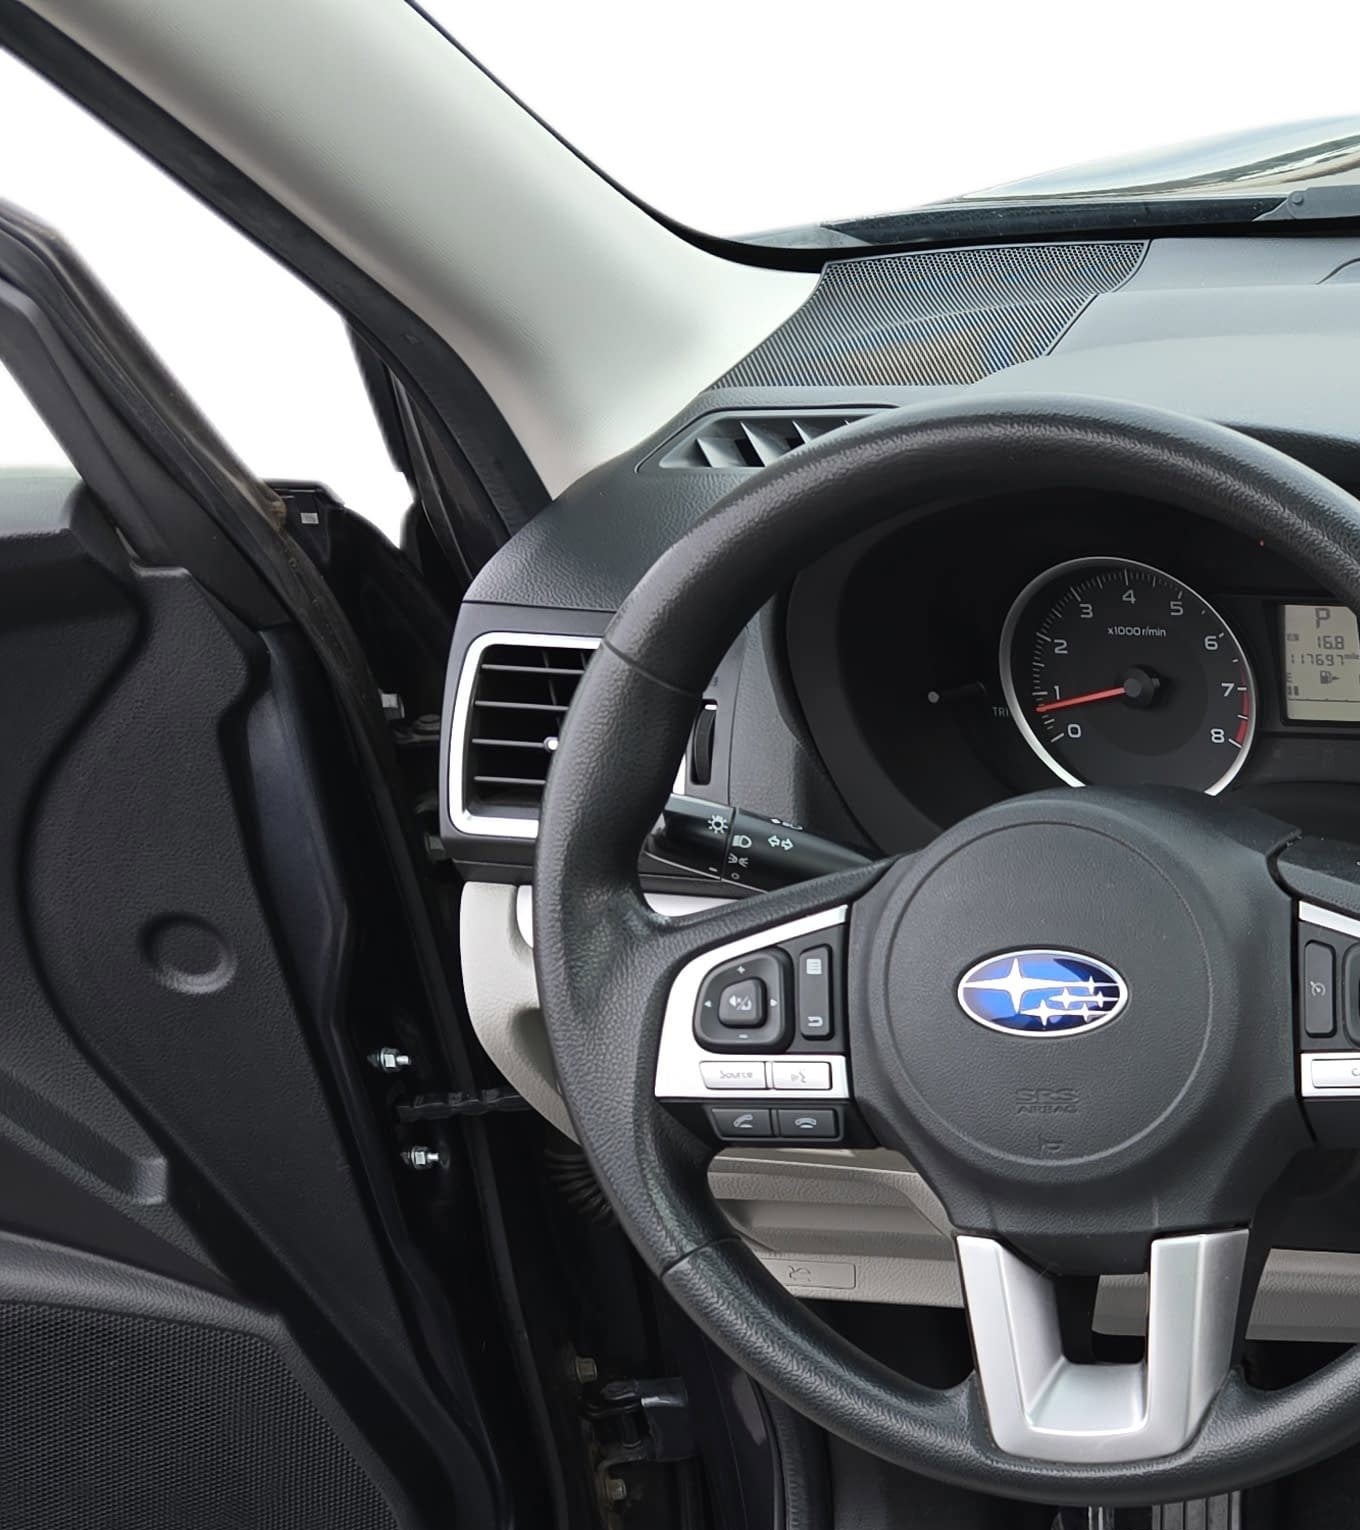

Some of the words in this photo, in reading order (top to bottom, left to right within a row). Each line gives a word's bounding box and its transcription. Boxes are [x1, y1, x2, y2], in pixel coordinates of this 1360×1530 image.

[1122, 590, 1136, 604] 4
[1080, 604, 1093, 618] 3
[1170, 601, 1184, 615] 5
[1315, 608, 1331, 629] P
[1054, 640, 1068, 654] 2
[1205, 636, 1218, 650] 6
[1221, 683, 1235, 697] 7
[1067, 724, 1081, 738] 0
[1211, 729, 1224, 743] 8
[719, 1070, 753, 1079] Source
[1016, 1087, 1080, 1105] SRS
